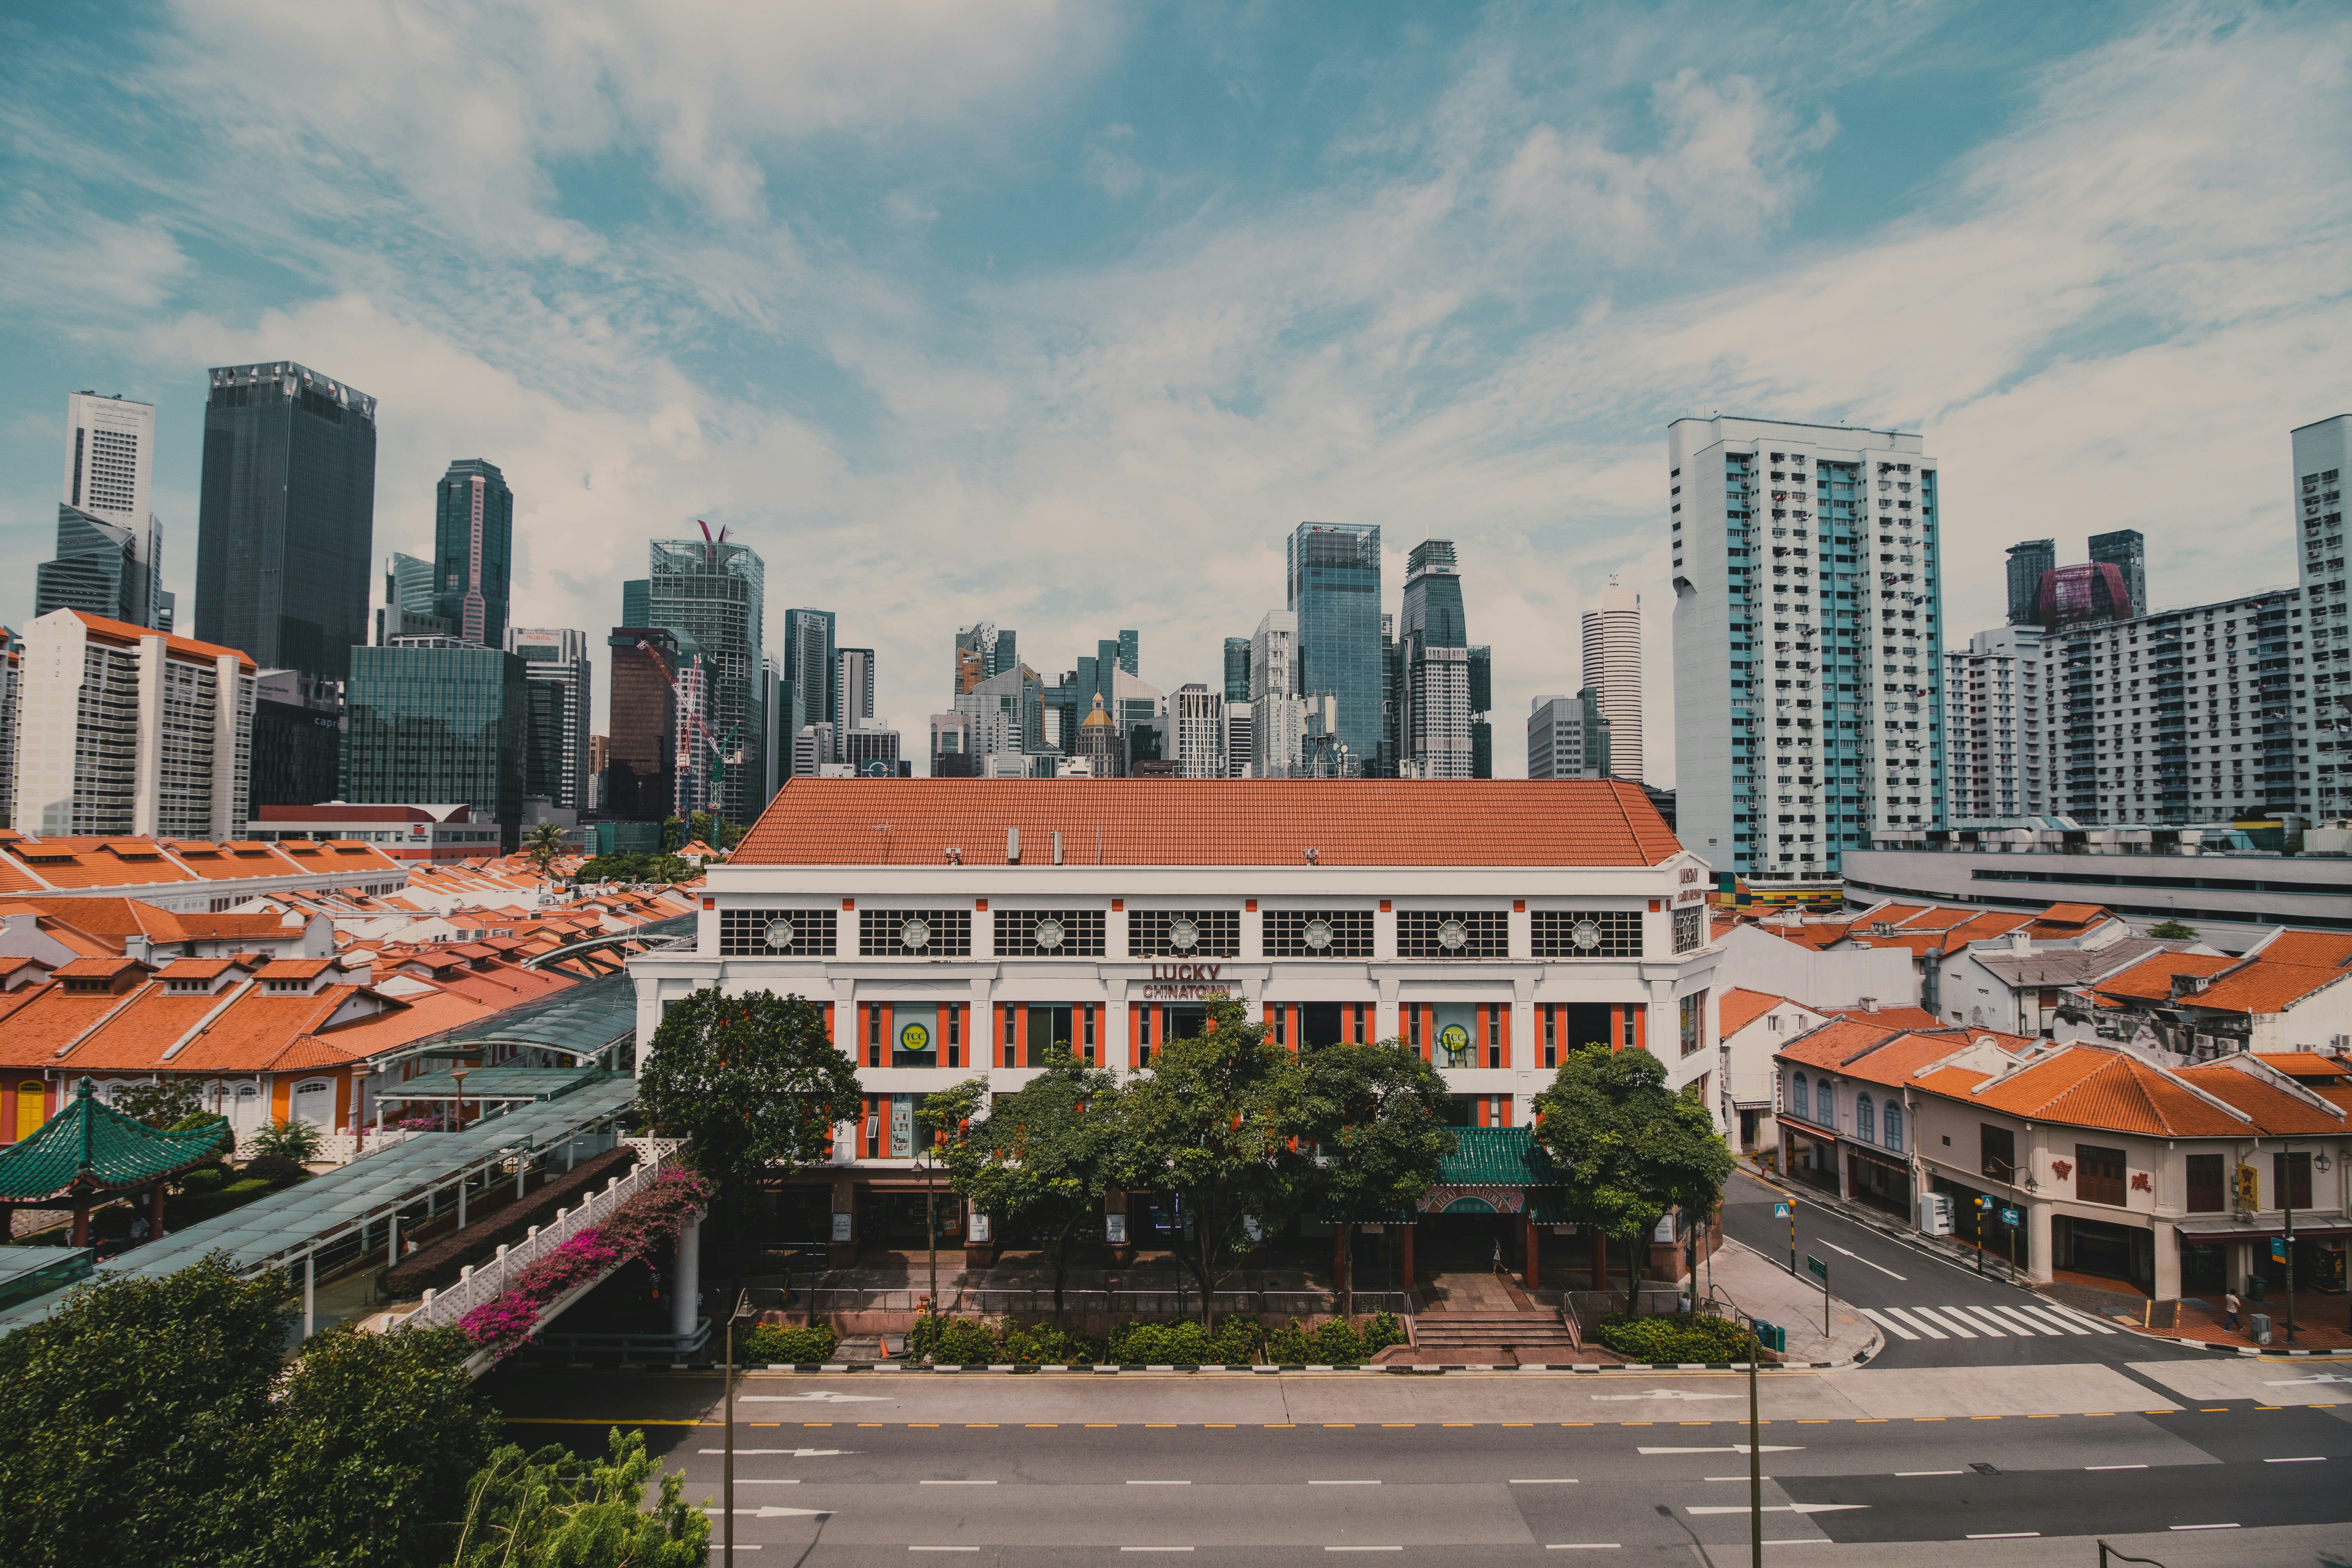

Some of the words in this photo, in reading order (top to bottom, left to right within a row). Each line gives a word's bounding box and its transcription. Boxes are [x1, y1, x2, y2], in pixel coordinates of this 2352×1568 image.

[1681, 868, 1699, 884] LUCKY
[1152, 965, 1221, 980] LUCKY
[1143, 985, 1230, 997] CHINATOWN
[1435, 1188, 1457, 1208] LUCKY
[1461, 1186, 1505, 1209] CHINATOWN
